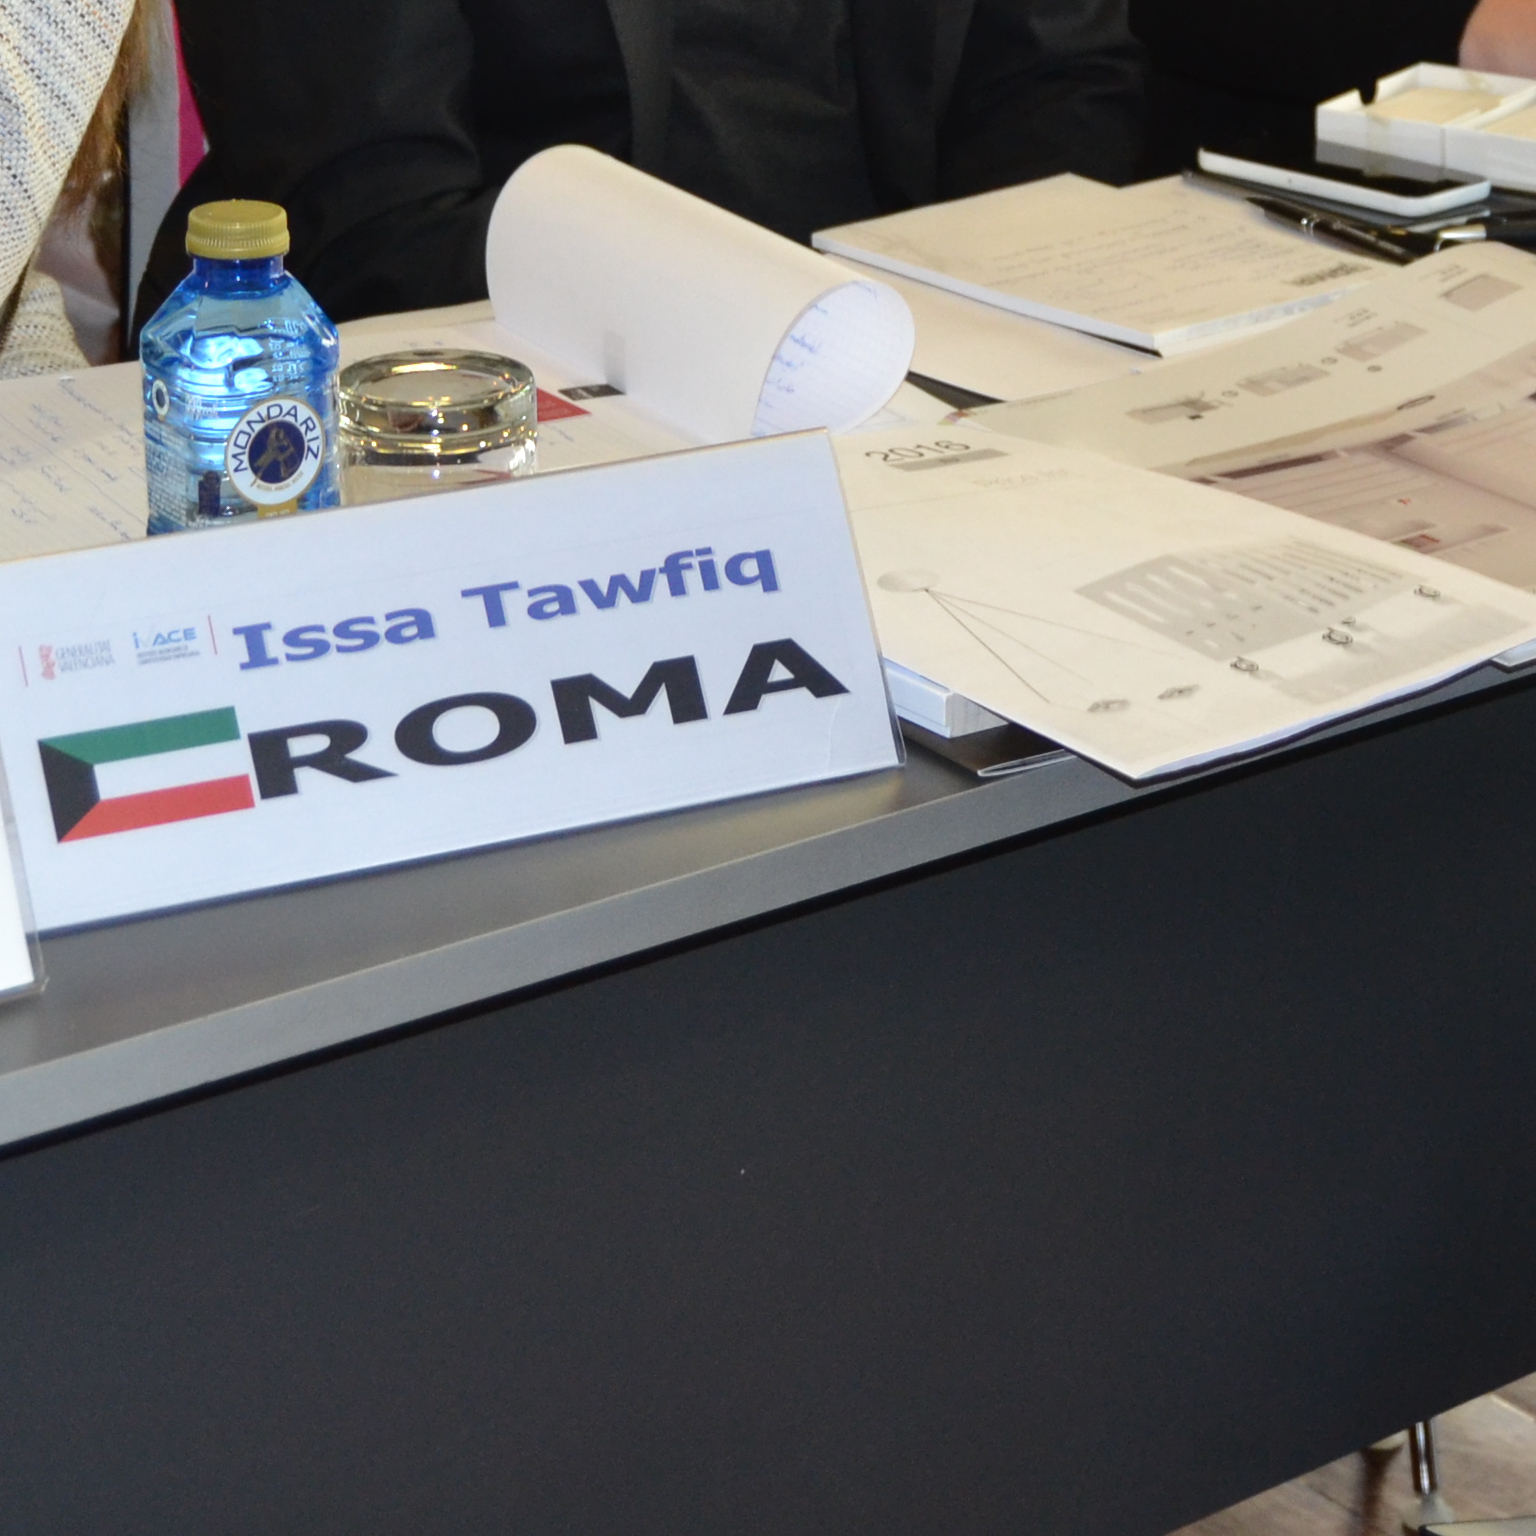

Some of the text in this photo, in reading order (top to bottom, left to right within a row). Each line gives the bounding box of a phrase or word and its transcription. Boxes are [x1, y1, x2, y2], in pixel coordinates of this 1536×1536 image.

[231, 403, 320, 473] MONDARIZ
[865, 439, 971, 463] 2016
[232, 546, 781, 671] Issa Tawfiq
[247, 637, 851, 801] ROMA
